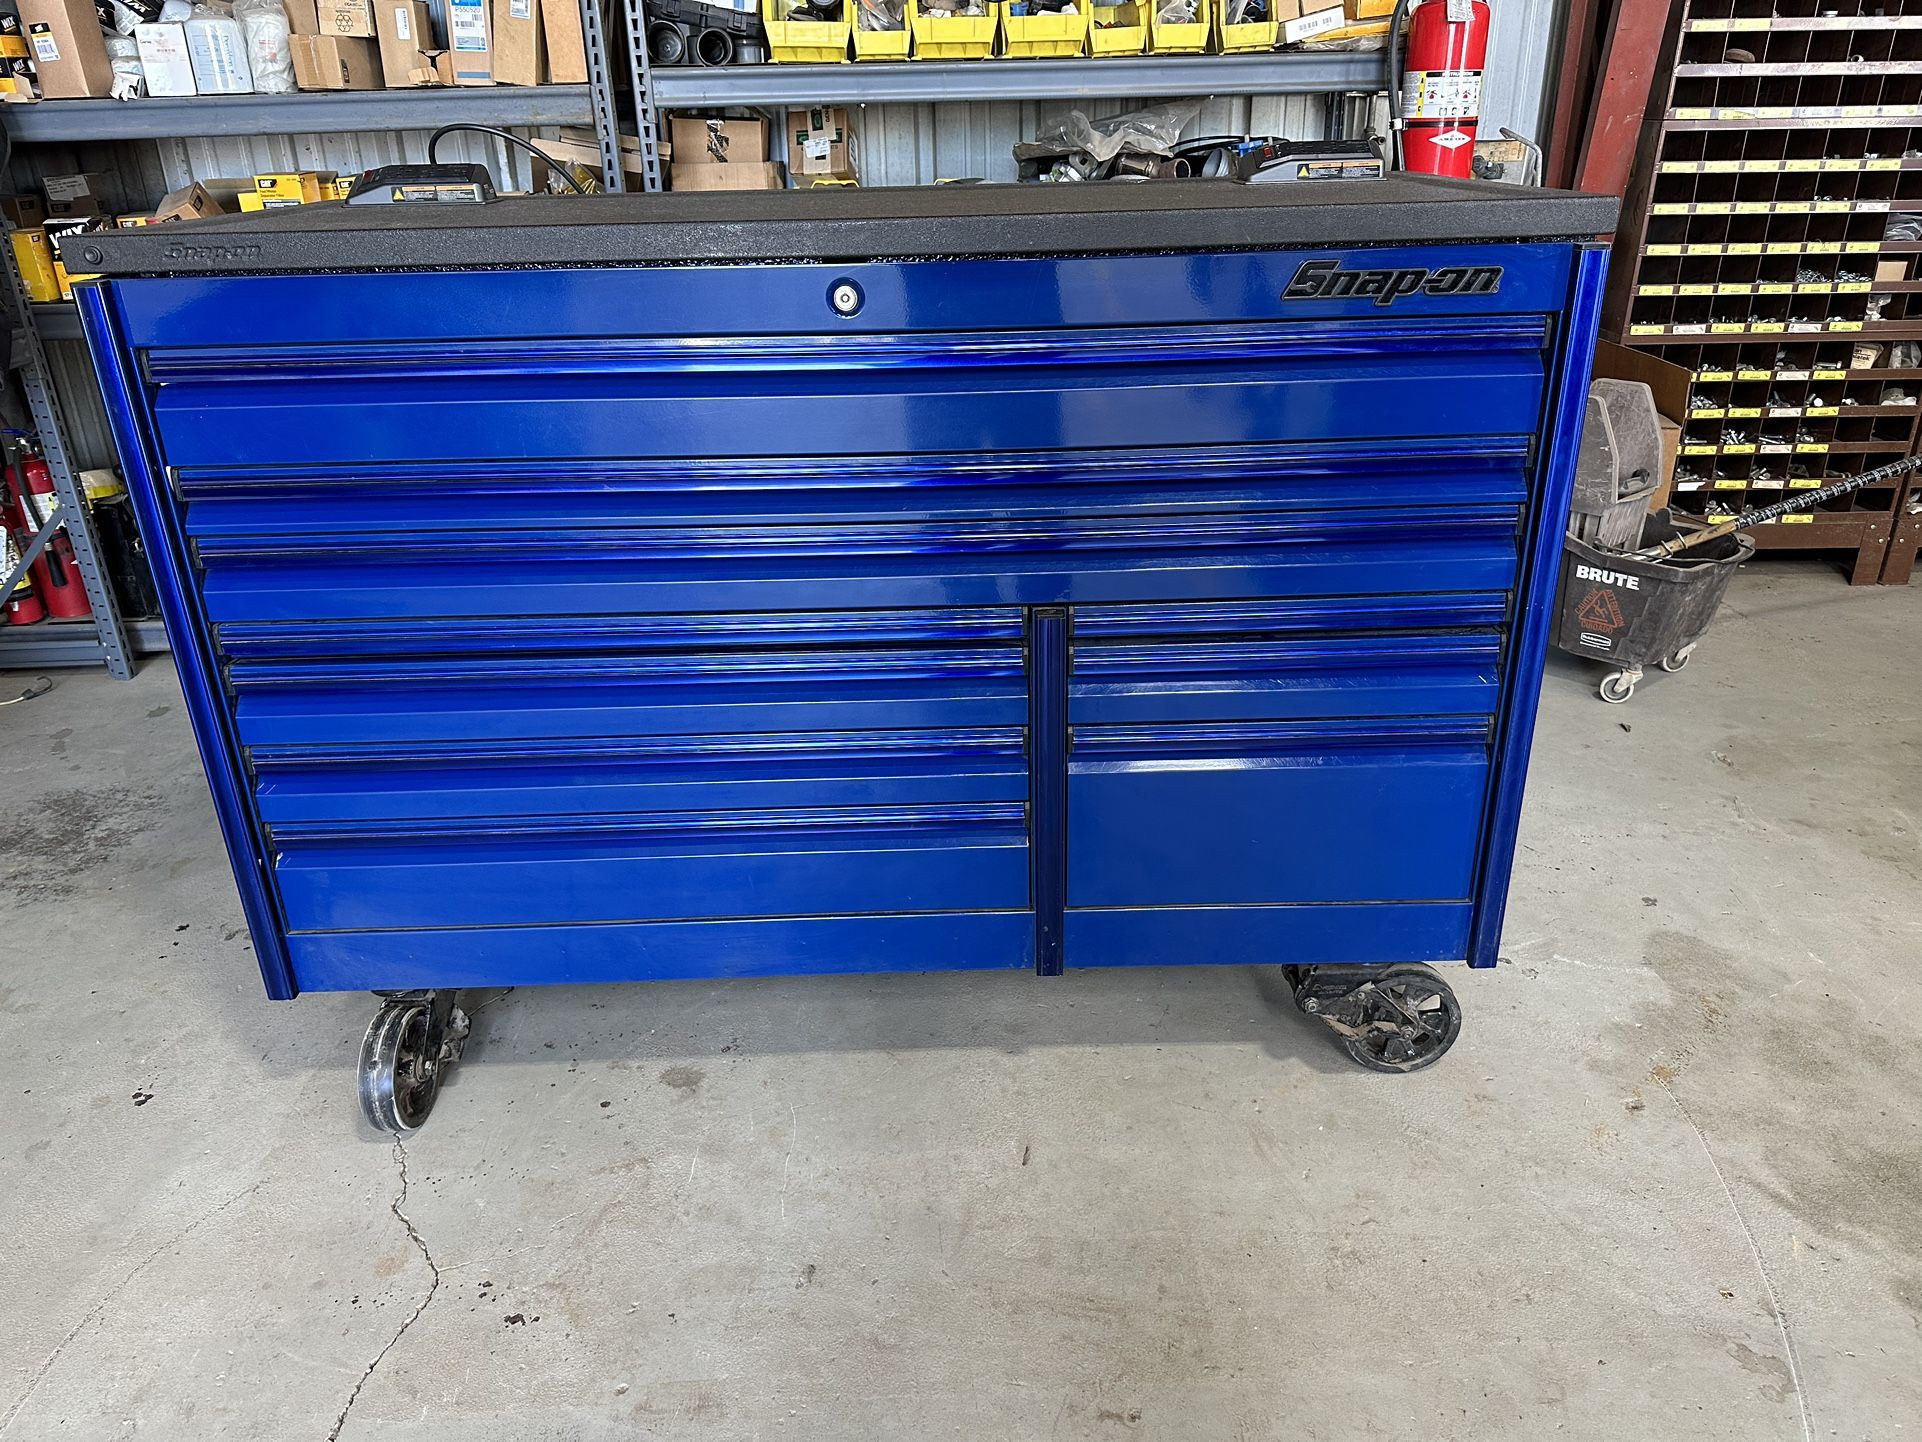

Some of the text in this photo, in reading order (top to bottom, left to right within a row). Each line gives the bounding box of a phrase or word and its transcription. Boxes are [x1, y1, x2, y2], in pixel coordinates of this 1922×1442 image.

[1, 16, 16, 29] WIX
[1281, 259, 1505, 306] Snap-on
[1576, 564, 1639, 590] BRUTE
[1574, 587, 1599, 615] CAUTION
